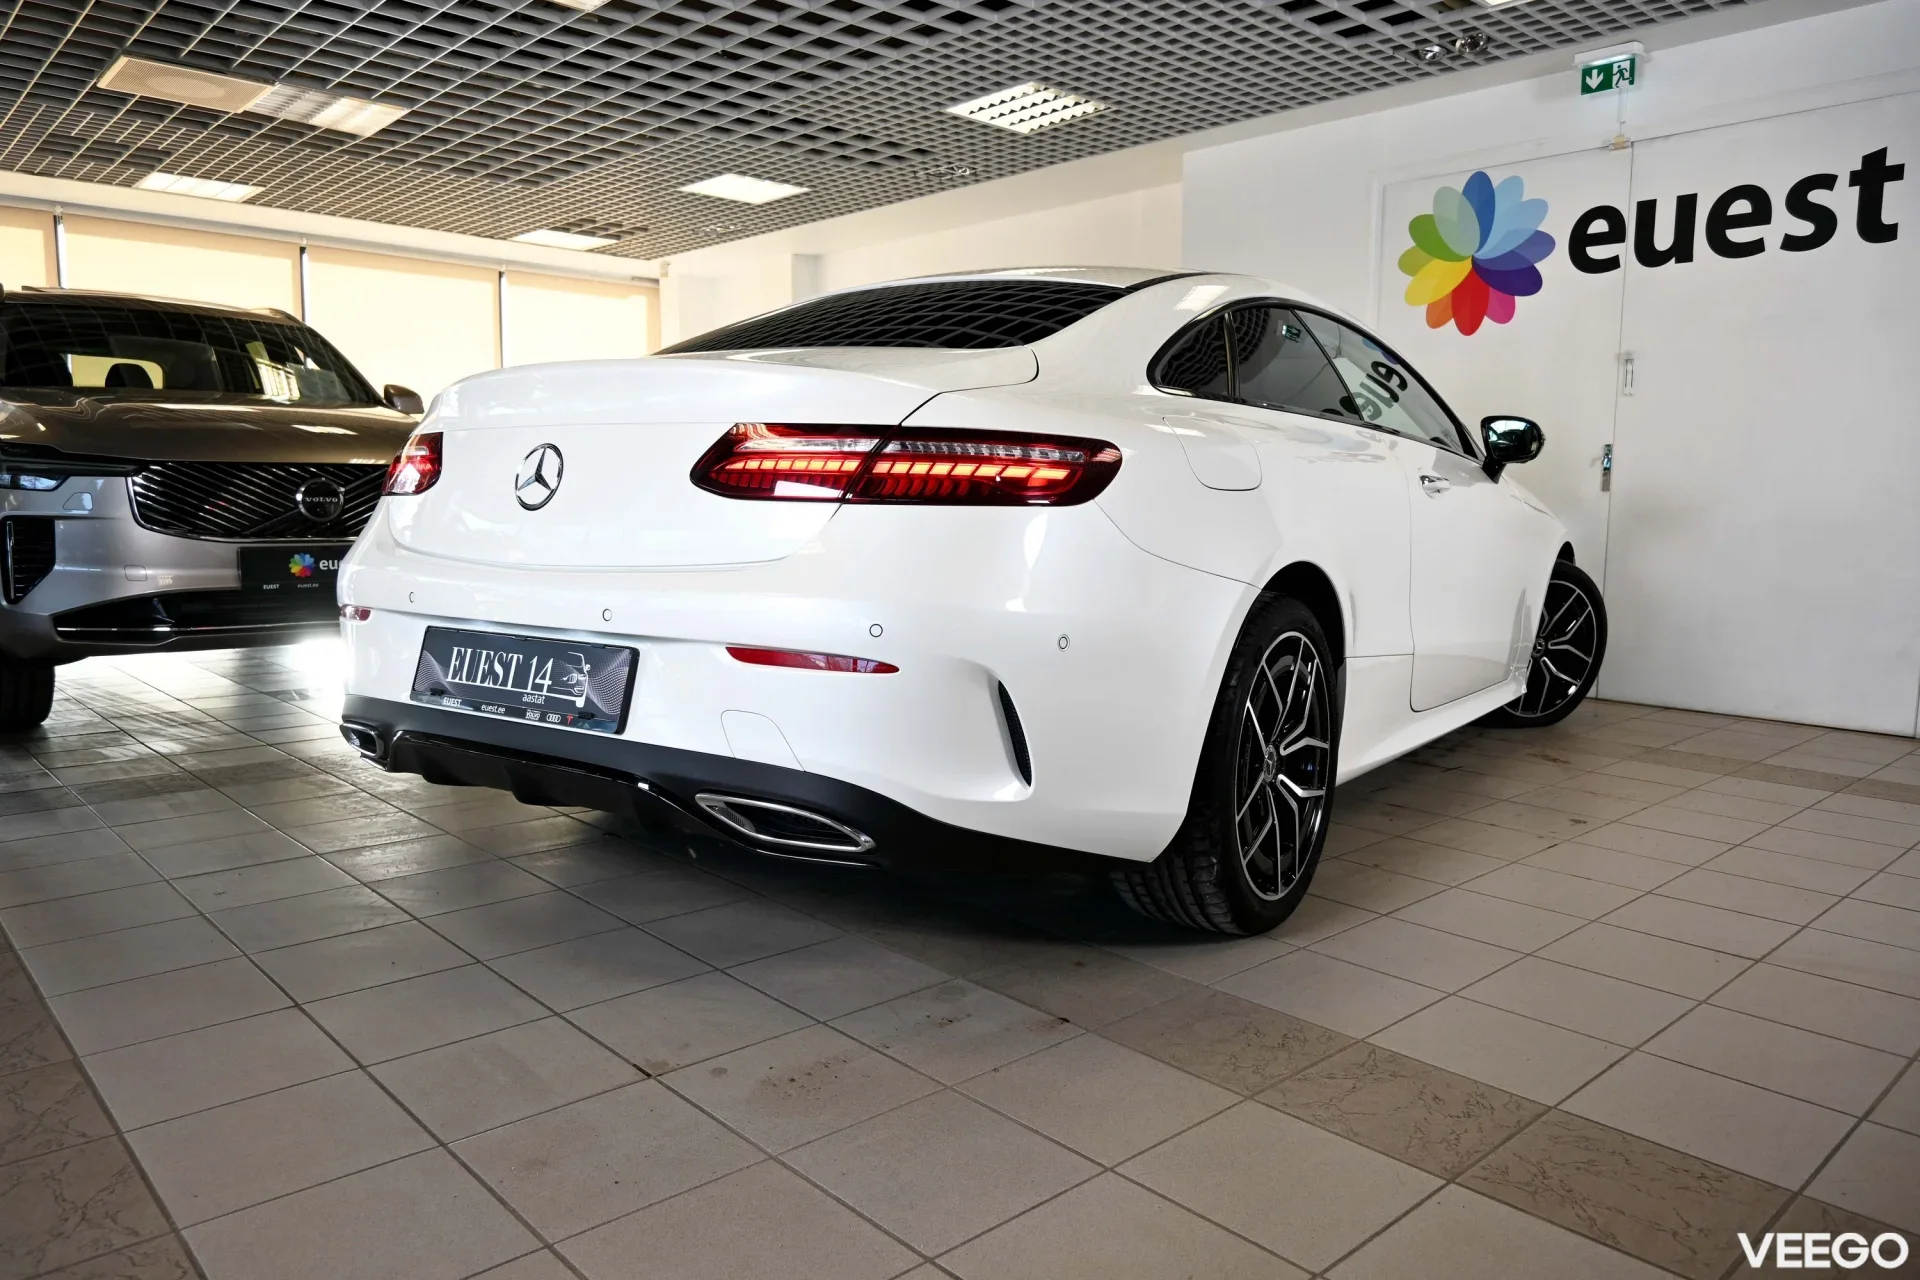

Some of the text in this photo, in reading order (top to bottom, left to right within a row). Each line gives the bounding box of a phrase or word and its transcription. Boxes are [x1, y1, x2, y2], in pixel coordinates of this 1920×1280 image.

[1568, 146, 1905, 274] euest
[446, 646, 554, 694] EUEST 14
[443, 697, 462, 707] EUEST
[522, 693, 545, 705] aastat
[481, 704, 506, 714] euest.ee
